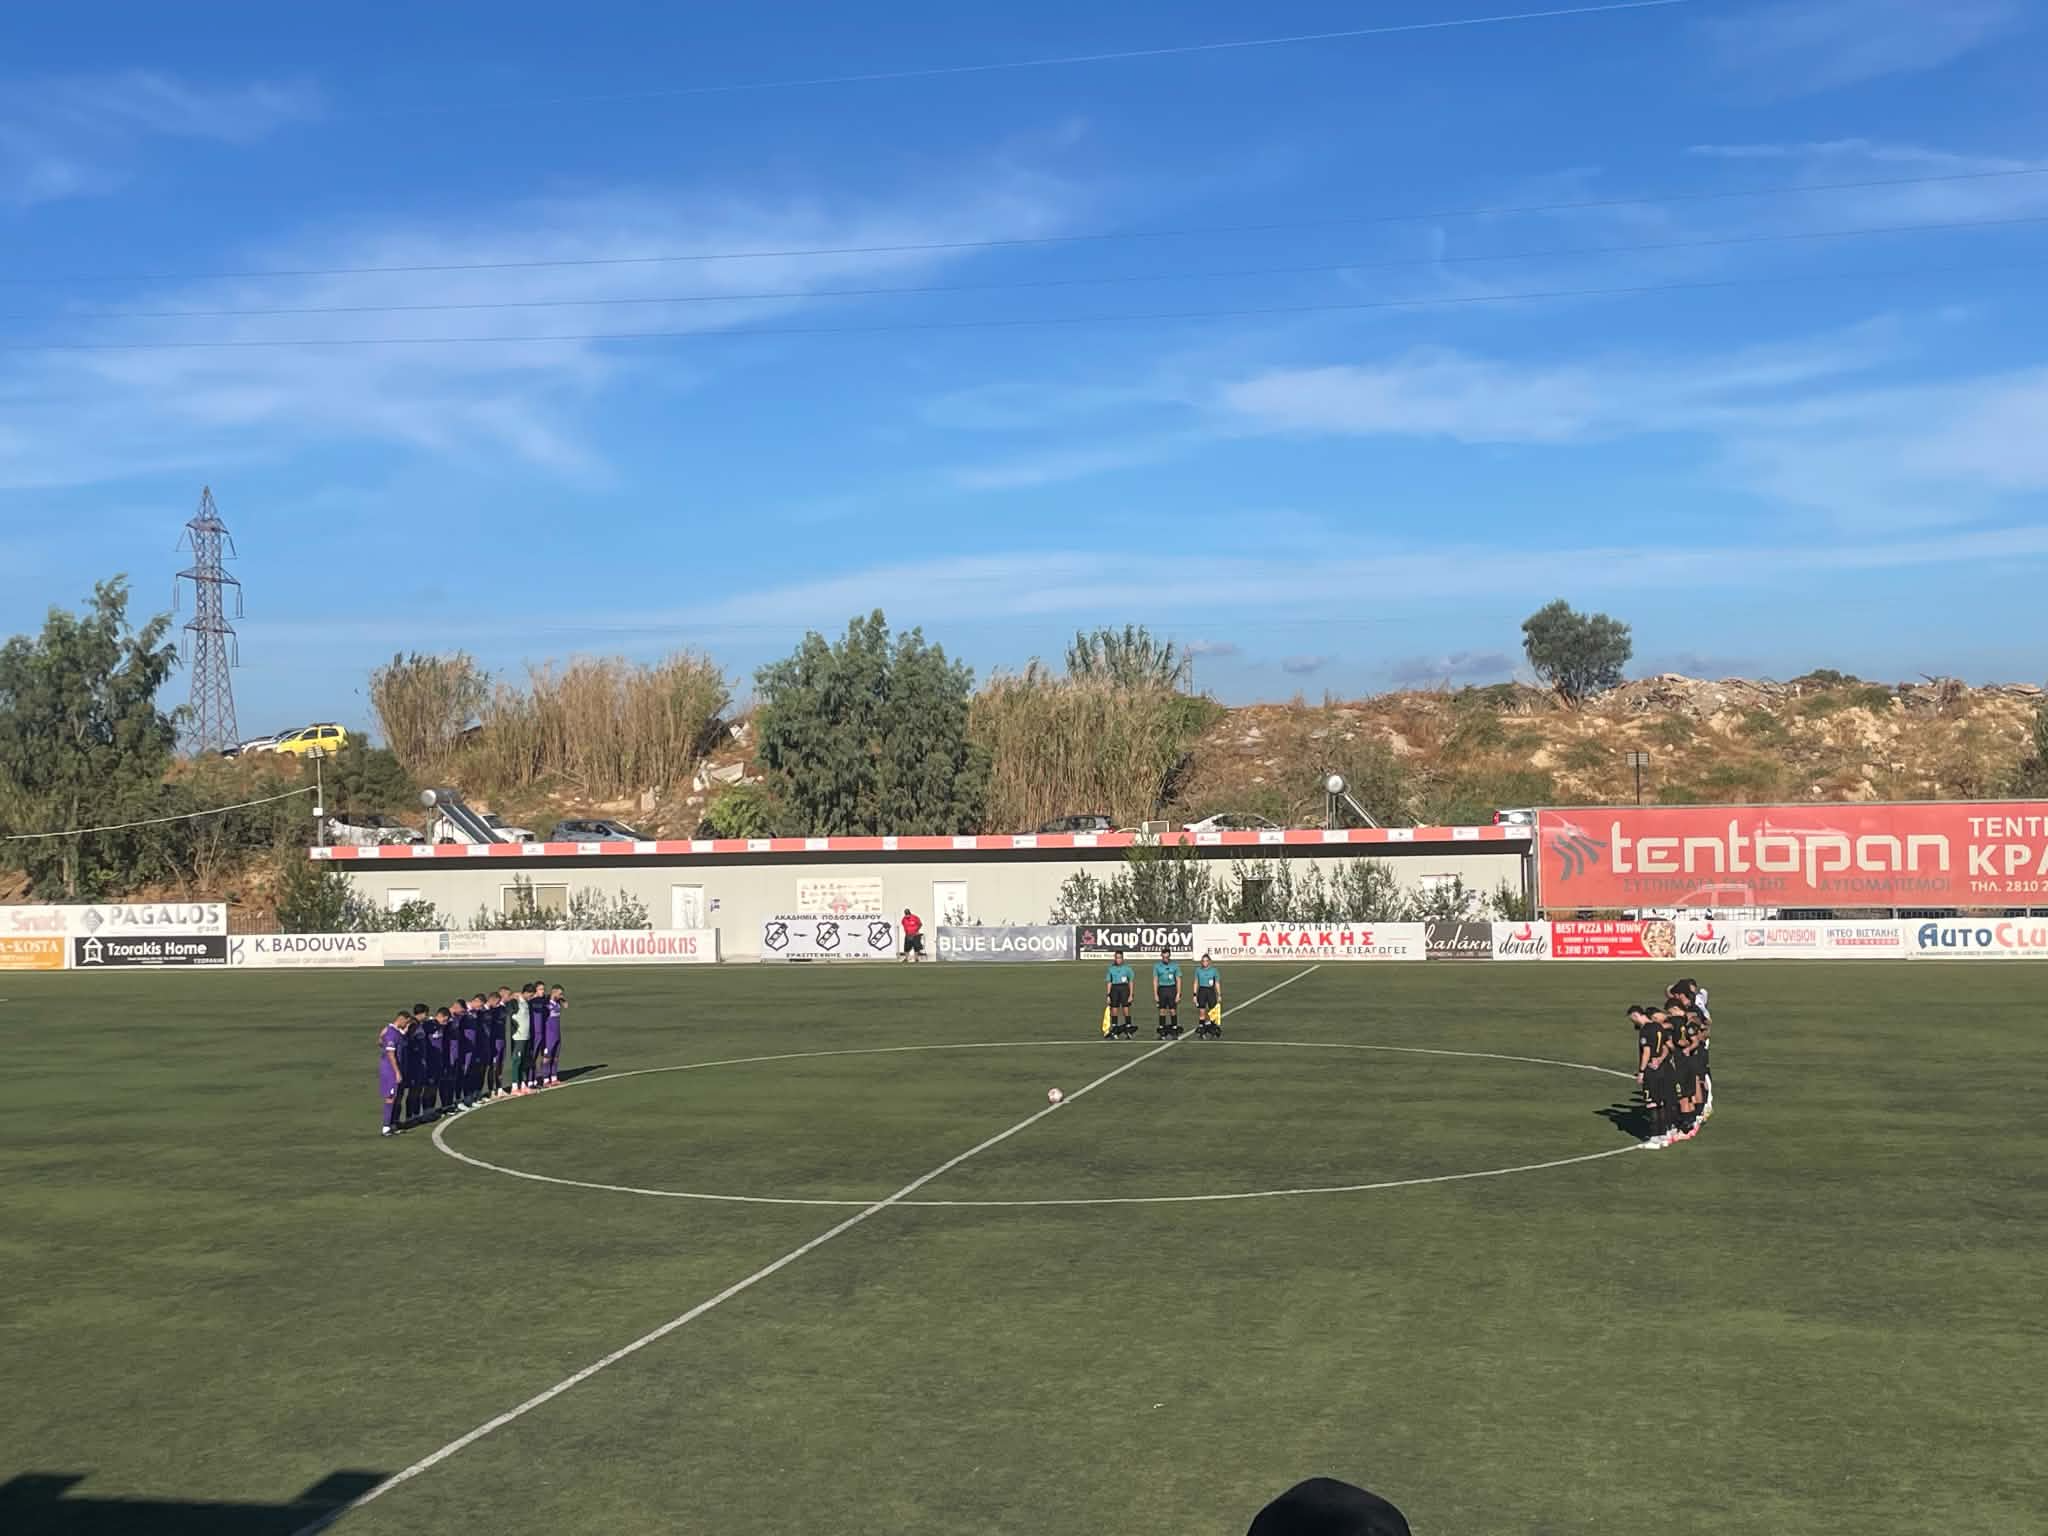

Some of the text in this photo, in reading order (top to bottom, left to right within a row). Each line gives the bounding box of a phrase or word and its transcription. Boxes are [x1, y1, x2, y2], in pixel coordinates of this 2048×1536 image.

[1968, 816, 2048, 837] ΤΕΝΤ
[1611, 820, 1951, 888] tentopan
[2006, 880, 2039, 893] 2810
[109, 905, 219, 925] PAGALOS
[1261, 923, 1351, 932] ΑΥΤΟΚΙΝΗΤΑ
[1555, 923, 1641, 934] BEST PIZZA IN TOWN
[939, 936, 1068, 951] BLUE LAGOON
[1238, 931, 1375, 947] ΤΑΚΑΚΗΣ
[107, 942, 207, 956] Tzorakis Home
